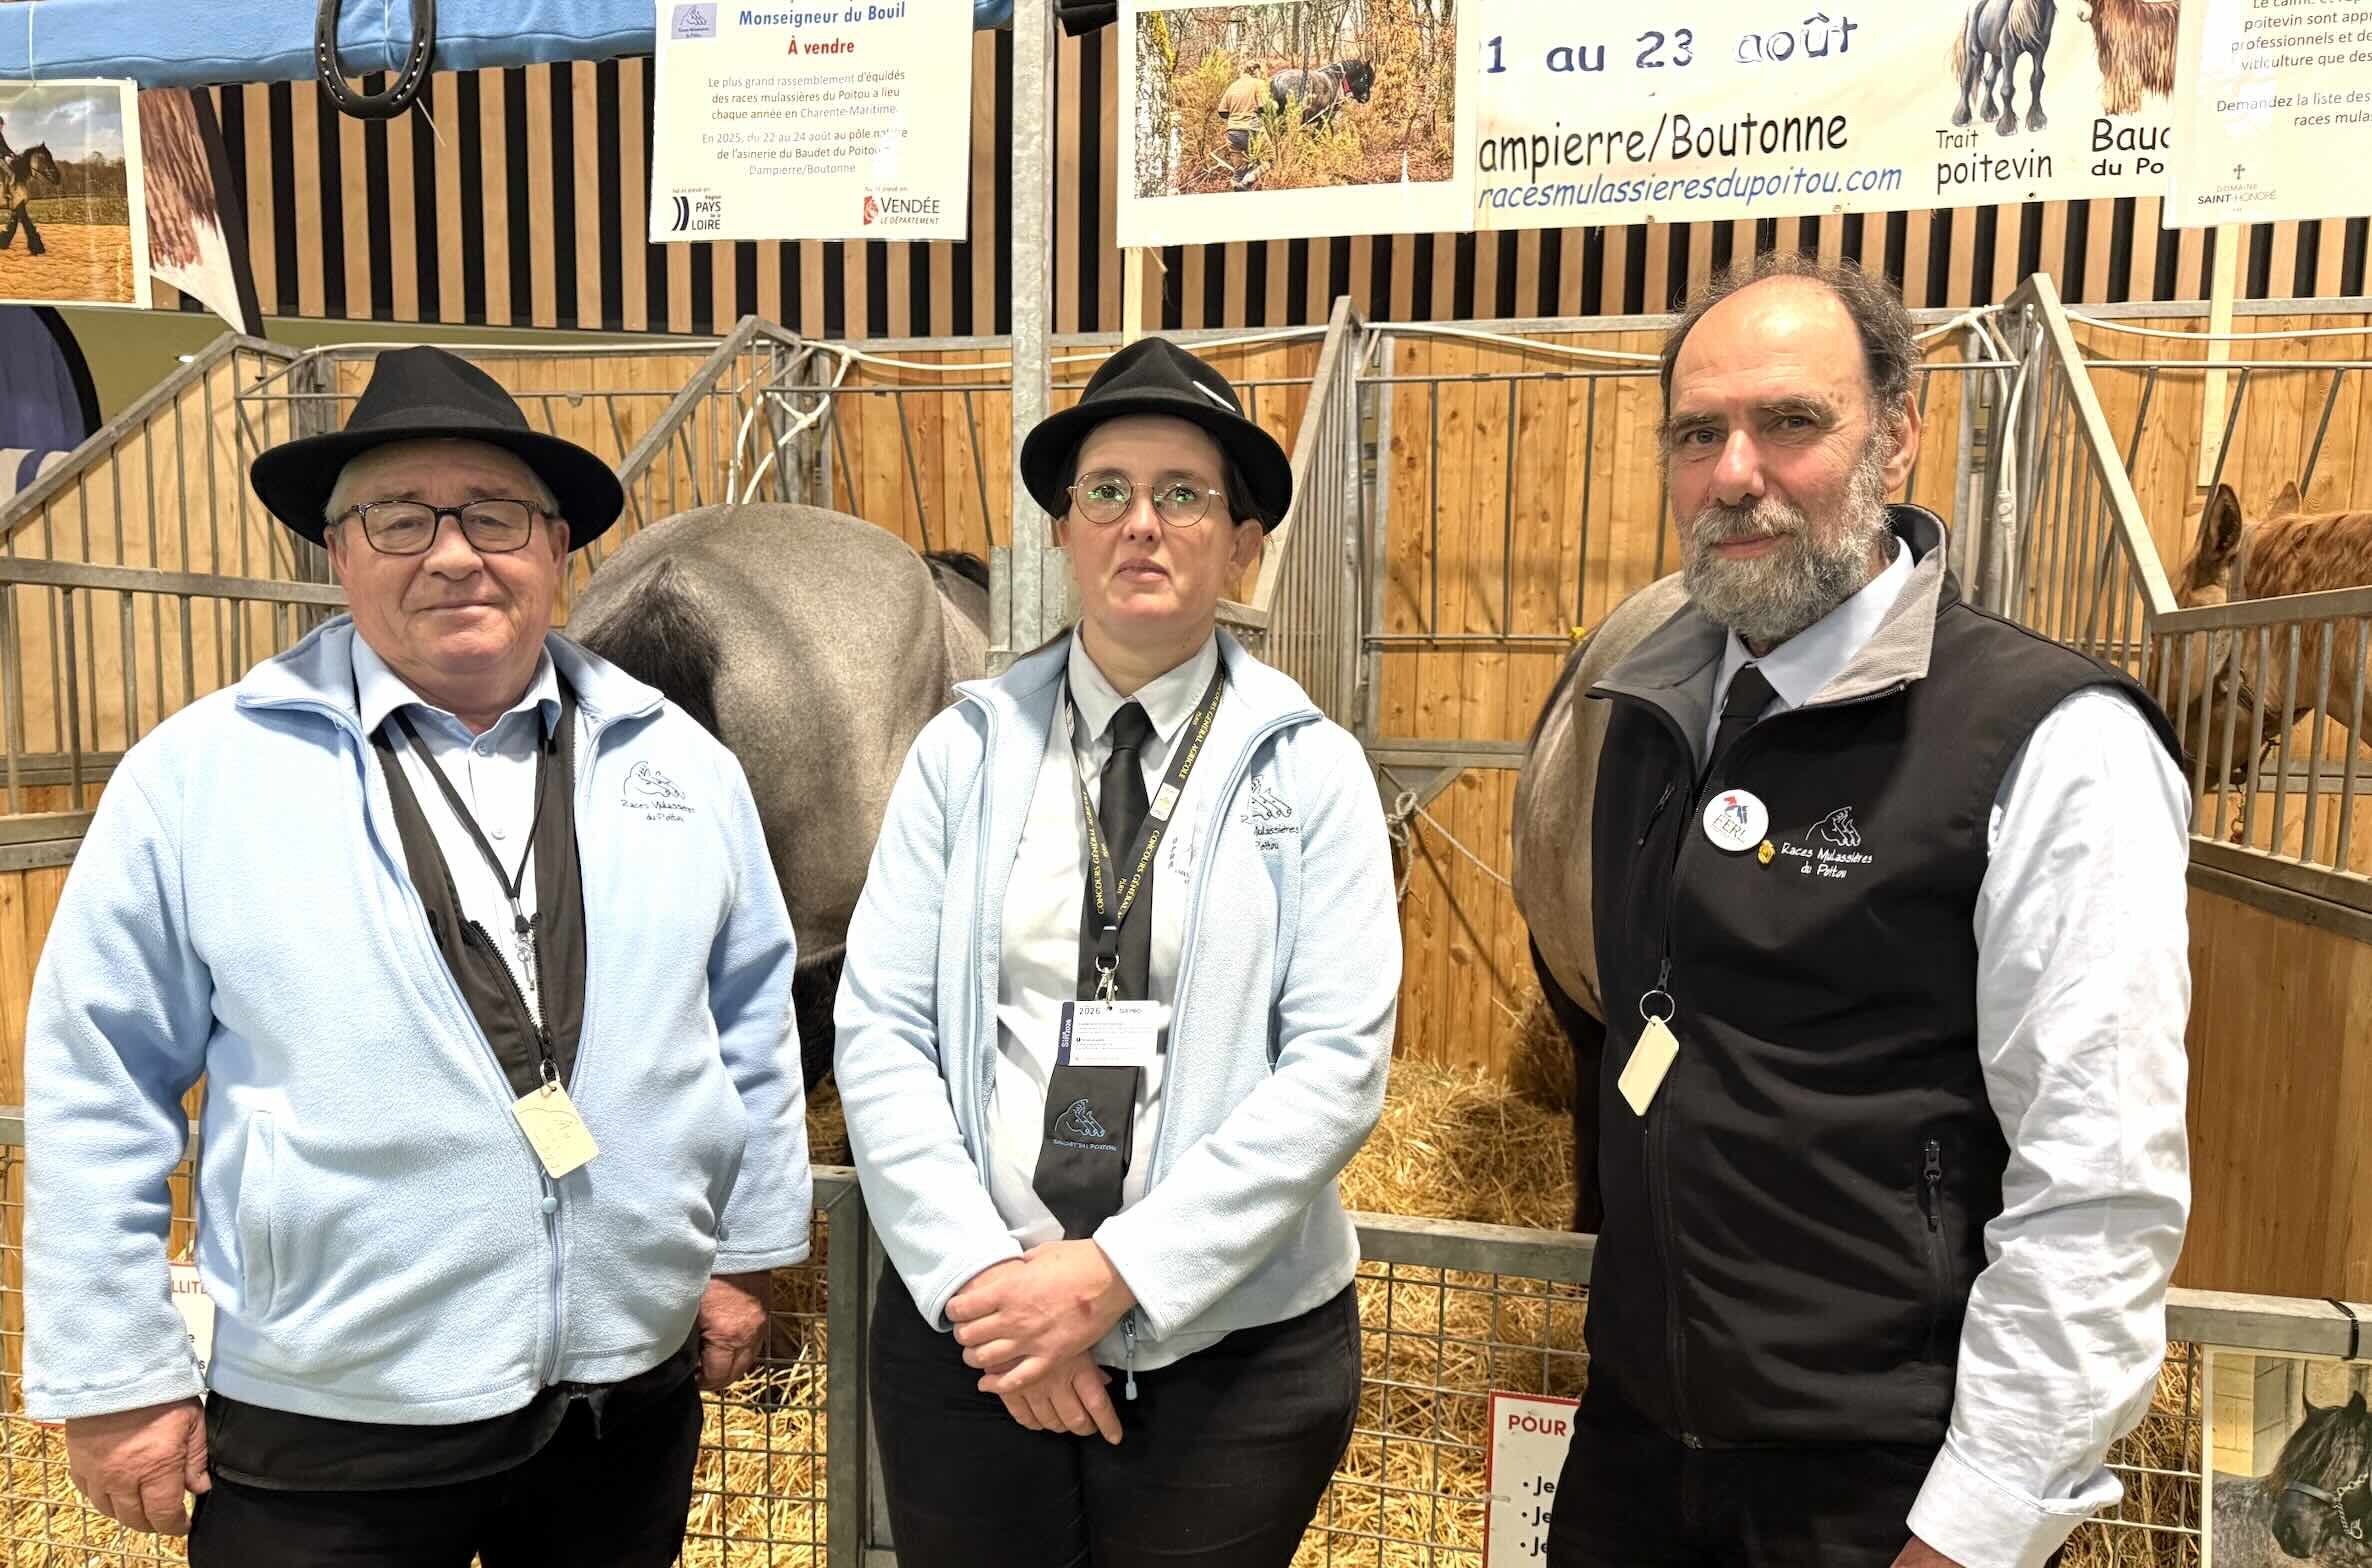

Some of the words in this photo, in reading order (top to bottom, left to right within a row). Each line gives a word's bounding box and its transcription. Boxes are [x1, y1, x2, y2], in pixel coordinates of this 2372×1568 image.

[739, 10, 838, 27] Monseigneur
[844, 6, 862, 22] du
[868, 1, 904, 20] Bouil
[2244, 14, 2302, 32] poitevin
[2307, 12, 2337, 24] sont
[788, 34, 798, 55] À
[804, 37, 854, 54] vendre
[1480, 36, 1506, 73] 1
[1546, 45, 1605, 72] au
[1636, 28, 1693, 69] 23
[1735, 12, 1858, 63] août
[2231, 32, 2334, 53] professionnels
[2338, 32, 2352, 42] et
[2318, 54, 2345, 66] que
[2349, 50, 2372, 62] des
[708, 77, 719, 87] Le
[722, 76, 742, 88] plus
[745, 76, 774, 89] grand
[777, 74, 854, 87] rassemblement
[712, 94, 729, 103] des
[732, 94, 757, 104] races
[761, 91, 820, 103] mulassières
[823, 90, 835, 101] du
[838, 89, 870, 100] Poitou
[881, 86, 900, 97] lieu
[2217, 96, 2293, 112] Demandez
[2297, 94, 2308, 106] la
[2313, 92, 2342, 104] liste
[2346, 90, 2370, 102] des
[712, 108, 748, 120] chaque
[750, 109, 782, 119] année
[785, 110, 797, 118] en
[2294, 115, 2330, 126] races
[702, 134, 713, 143] En
[763, 133, 775, 142] 22
[778, 133, 791, 142] au
[834, 132, 846, 141] au
[849, 129, 870, 141] pôle
[1936, 129, 1979, 149] Trait
[717, 149, 729, 160] de
[780, 147, 792, 158] du
[796, 146, 830, 158] Baudet
[833, 147, 846, 157] du
[849, 145, 881, 156] Poito
[1479, 113, 1847, 184] ampierre/Boutonne
[1937, 148, 2052, 195] poitevin
[2091, 158, 2122, 176] du
[2136, 157, 2164, 175] Po
[1478, 167, 1902, 209] racesmulassieresdupoitou.com
[696, 201, 721, 212] PAYS
[881, 196, 941, 213] VENDÉE
[692, 219, 721, 231] LOIRE
[1137, 830, 1160, 873] CONCOURS
[1781, 842, 1813, 858] Races
[1800, 860, 1812, 874] du
[1817, 863, 1847, 878] Poitou
[1079, 1007, 1101, 1015] 2026
[1508, 1414, 1567, 1437] POUR
[1533, 1475, 1555, 1496] Je
[1531, 1505, 1551, 1527] Je
